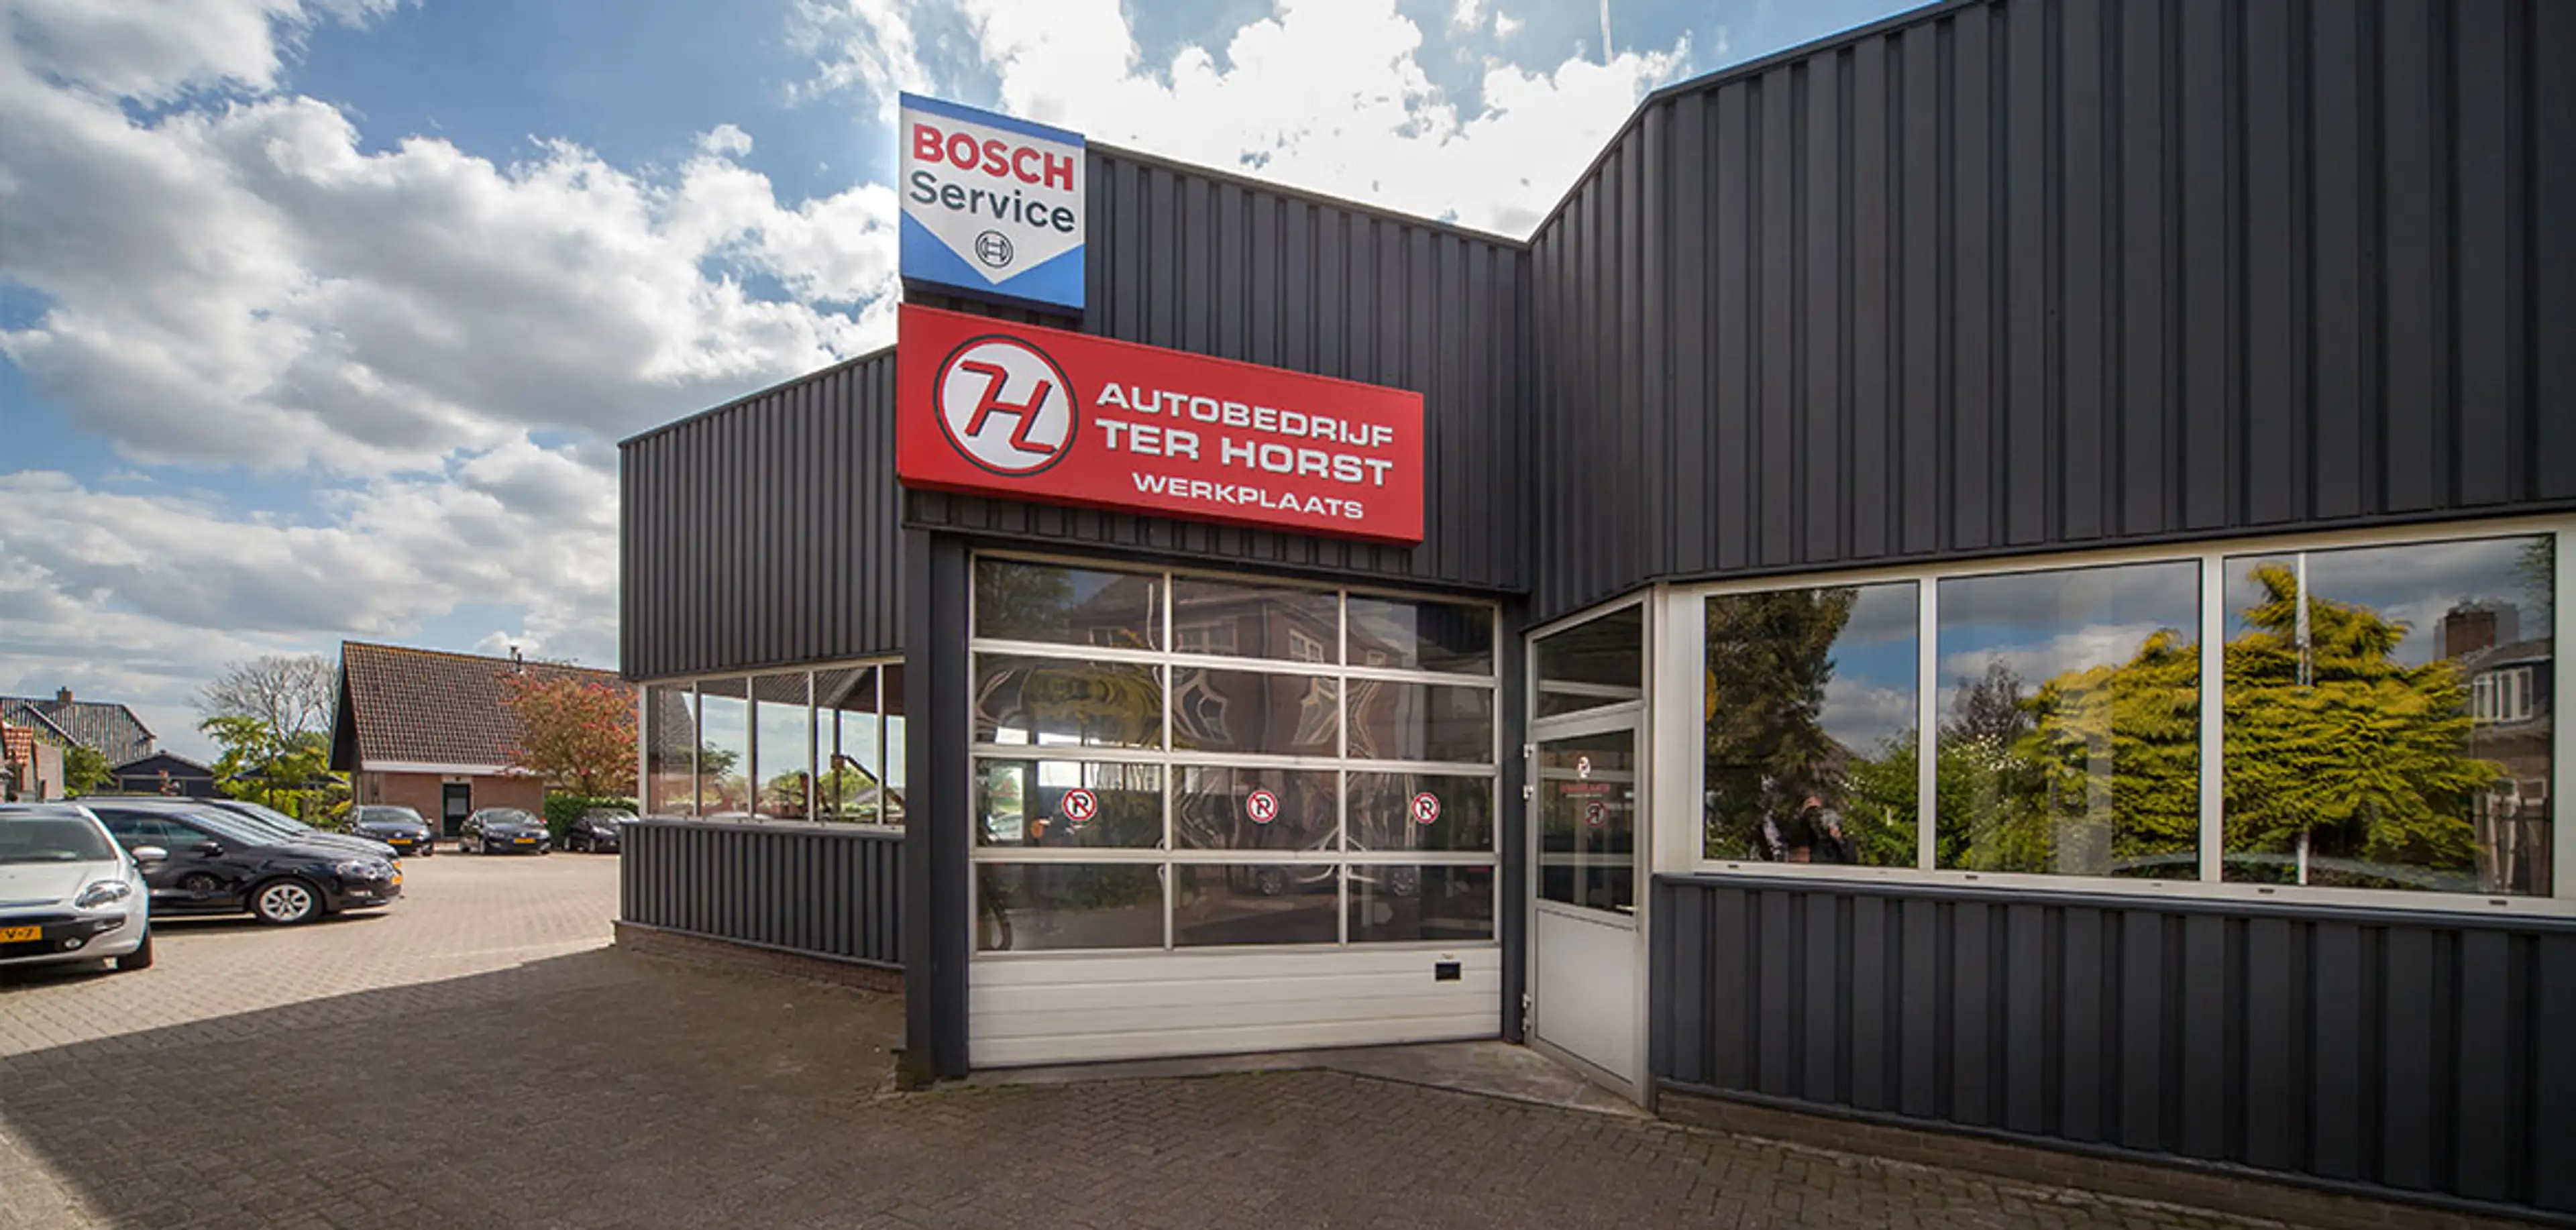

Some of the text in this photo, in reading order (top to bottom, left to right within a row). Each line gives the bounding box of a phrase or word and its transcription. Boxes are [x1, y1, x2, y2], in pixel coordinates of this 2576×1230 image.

[914, 123, 1073, 192] BOSCH
[910, 170, 1075, 232] Service
[1096, 382, 1393, 447] AUTOBEDRIJF
[1095, 418, 1393, 486] TER HORST
[1132, 471, 1364, 519] WERKPLAATS
